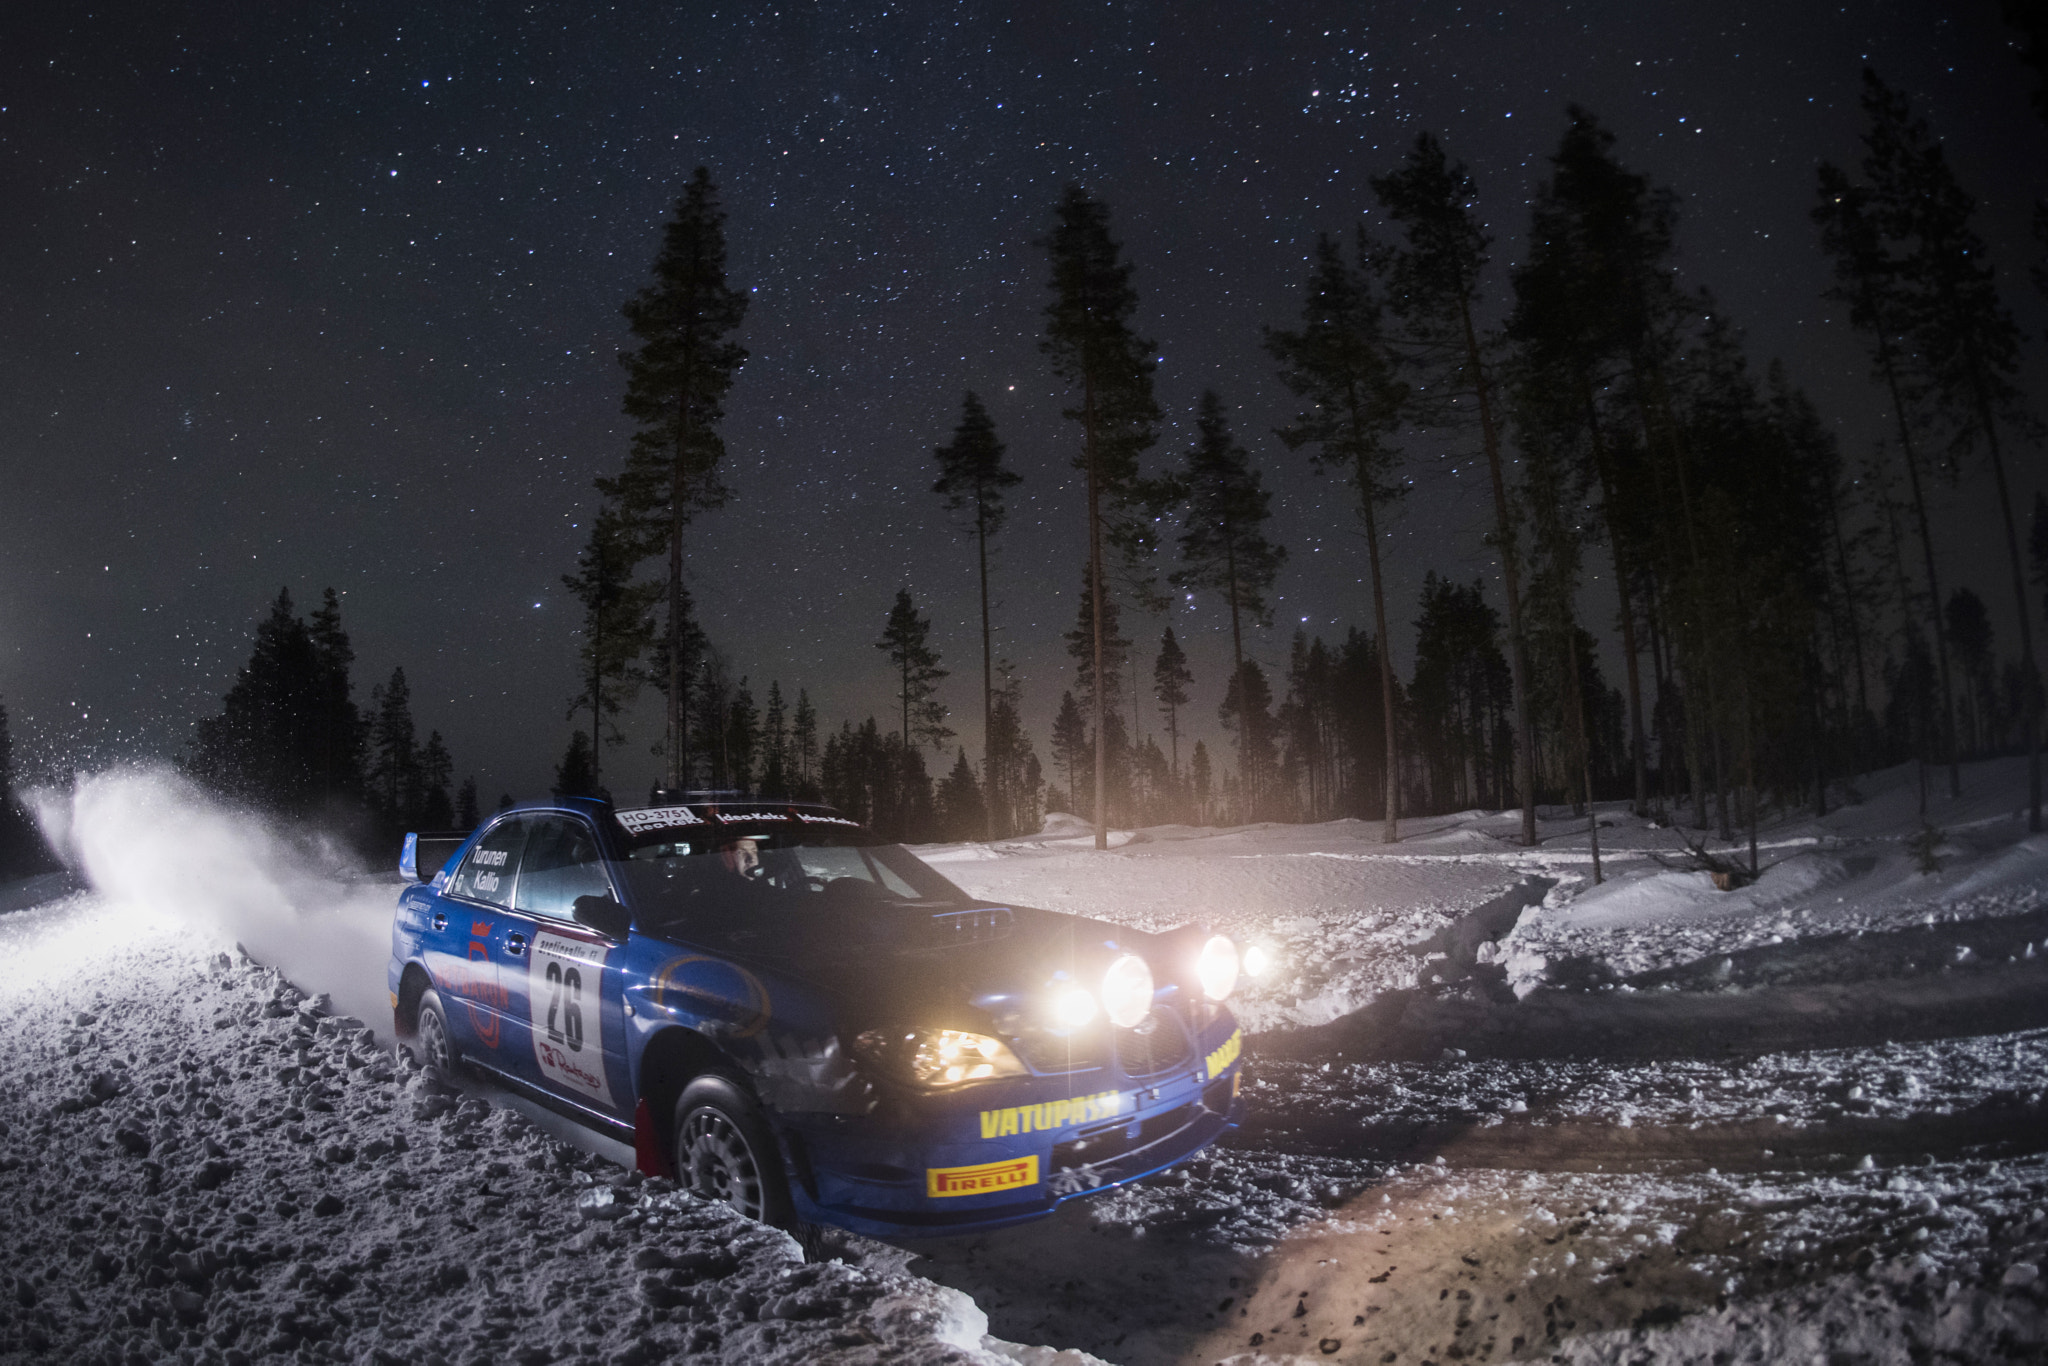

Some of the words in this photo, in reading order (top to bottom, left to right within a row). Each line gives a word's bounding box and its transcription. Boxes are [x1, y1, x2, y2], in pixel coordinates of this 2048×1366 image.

[472, 845, 508, 866] Turunen
[473, 870, 500, 892] Kallio
[545, 961, 583, 1052] 26
[936, 1162, 1028, 1192] PIRELLI
